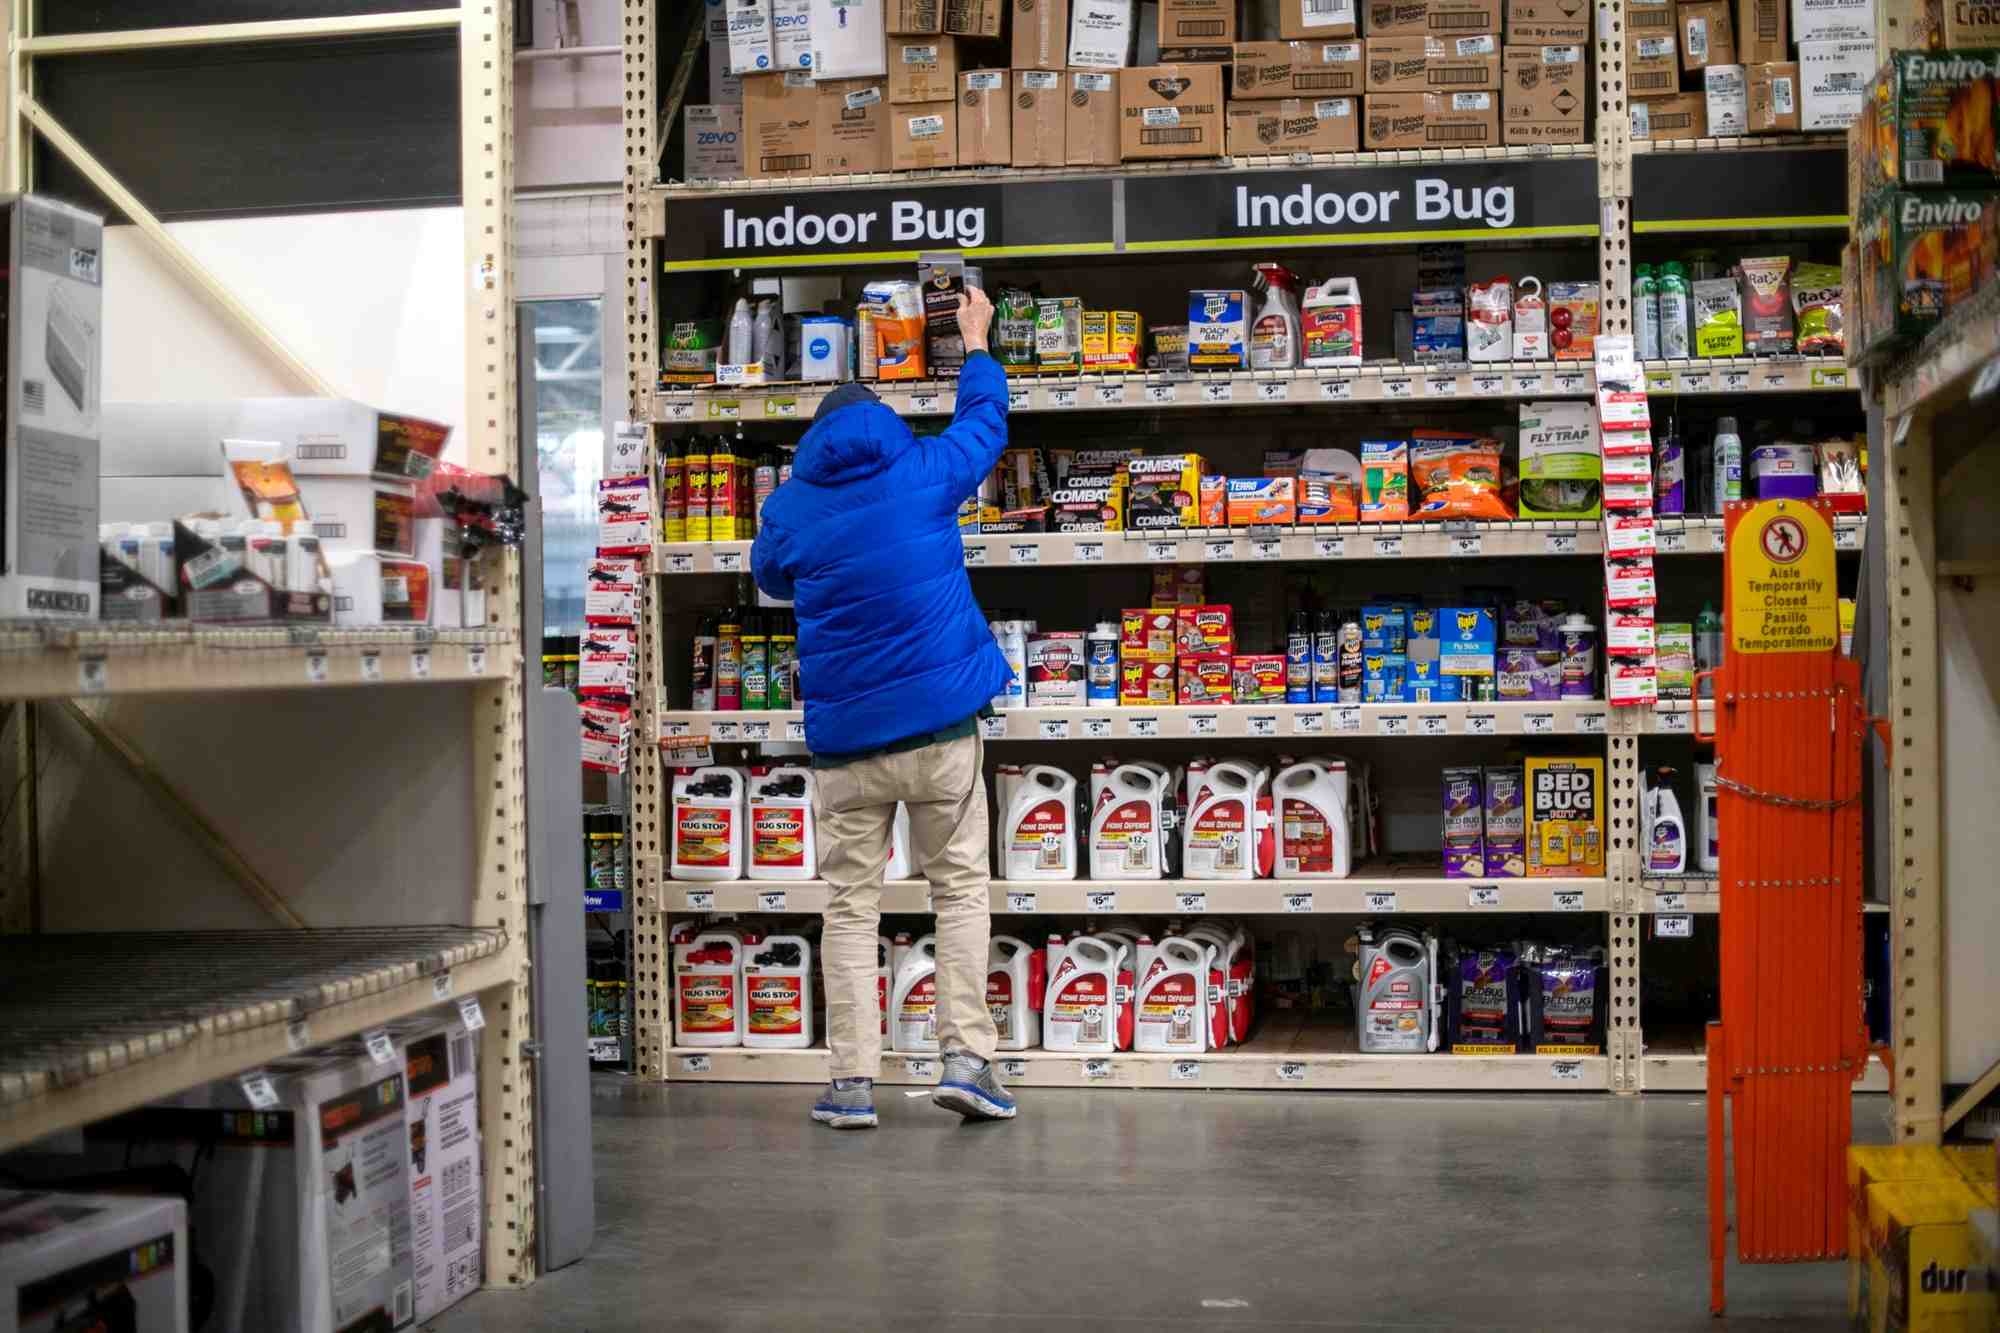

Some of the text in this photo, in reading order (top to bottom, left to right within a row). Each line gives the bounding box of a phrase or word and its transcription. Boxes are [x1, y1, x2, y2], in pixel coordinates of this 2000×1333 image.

[1550, 27, 1584, 37] Contact
[1545, 126, 1579, 136] Contact
[697, 131, 736, 146] zevo
[1236, 179, 1515, 228] Indoor Bug
[1900, 197, 1983, 224] Enviro
[724, 201, 985, 248] Indoor Bug
[1200, 328, 1229, 337] ROACH
[1530, 430, 1588, 448] FLY TRAP
[1129, 459, 1185, 474] COMBAT
[1052, 489, 1113, 504] COMBAT
[1136, 515, 1183, 528] COMBAT
[1060, 523, 1104, 534] COMBAT
[1770, 567, 1800, 579] Aisle
[1748, 580, 1823, 593] Temporarily
[1764, 595, 1808, 607] Closed
[1765, 612, 1807, 623] Pasillo
[1761, 624, 1811, 636] Cerrado
[1738, 637, 1833, 649] Temporalmente
[1538, 774, 1591, 792] BED
[1536, 792, 1593, 810] BUG
[681, 821, 727, 831] BUG STOP
[756, 821, 801, 831] BUG STOP
[685, 988, 729, 999] BUG STOP
[752, 990, 797, 1000] BUG STOP
